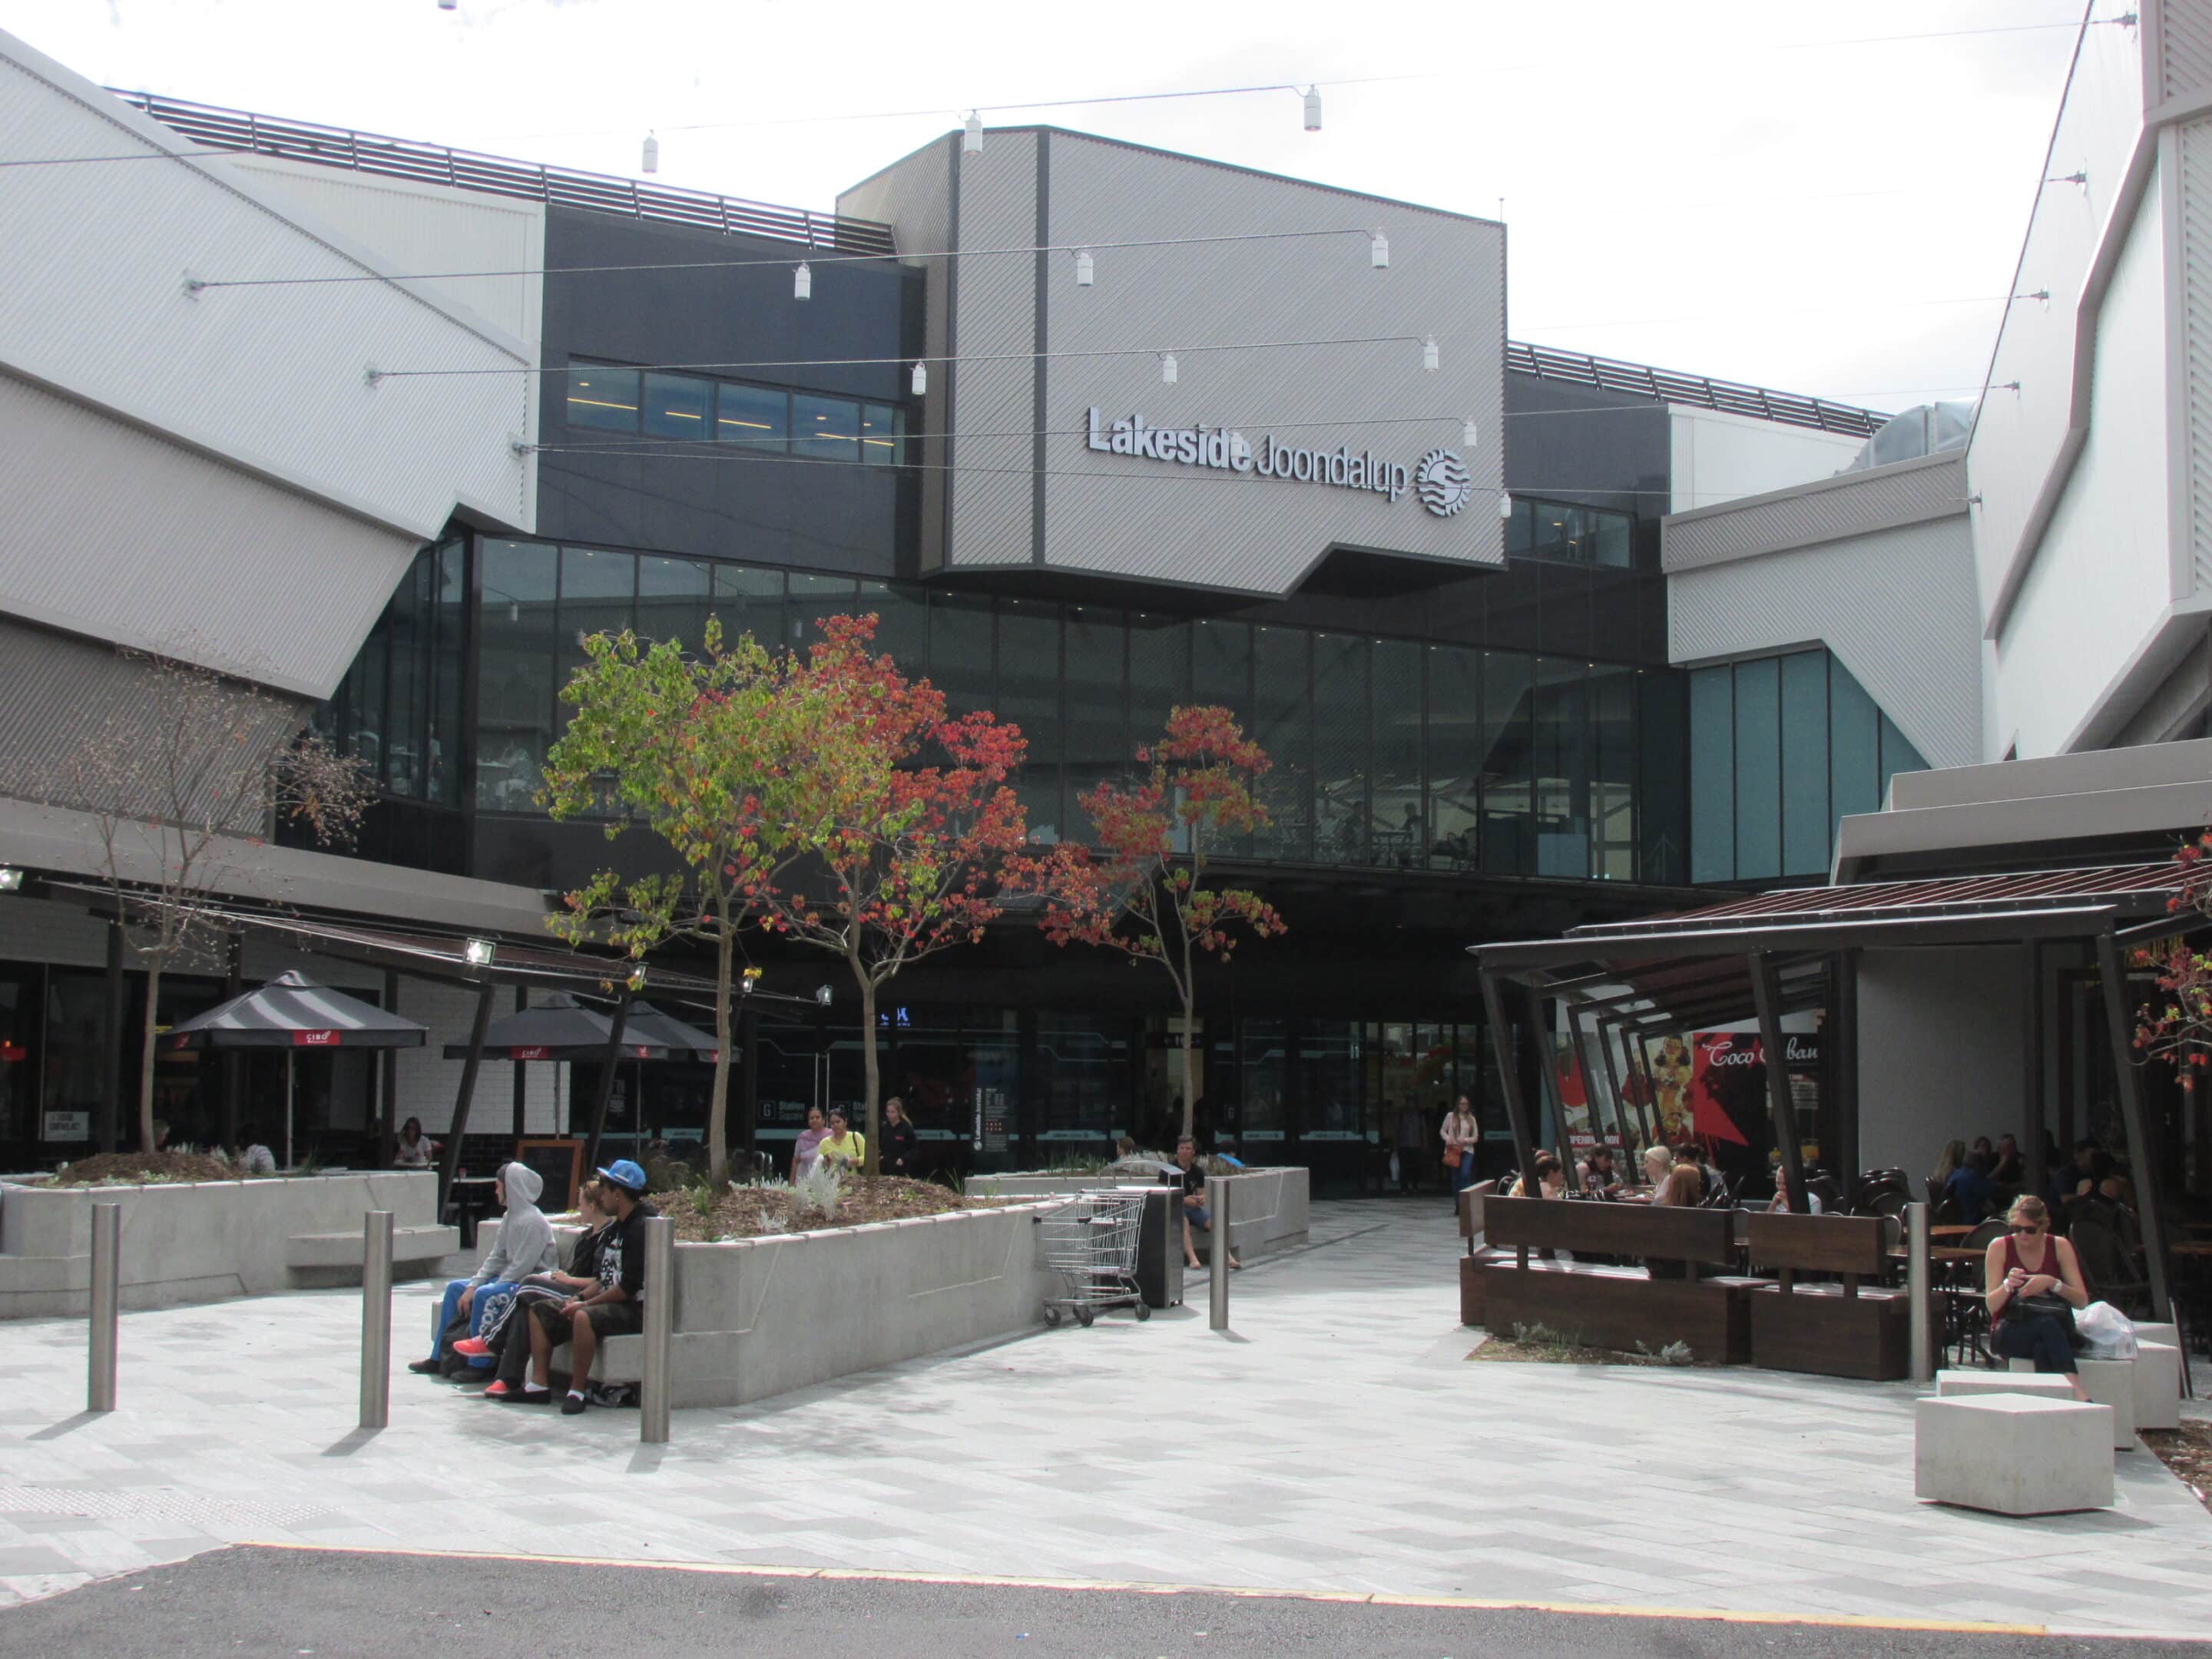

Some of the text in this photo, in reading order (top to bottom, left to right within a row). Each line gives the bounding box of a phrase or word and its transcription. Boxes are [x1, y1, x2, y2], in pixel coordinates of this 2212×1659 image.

[1088, 406, 1408, 502] Lakeside Joondalup
[1702, 1037, 1819, 1066] Coco ban
[1569, 1135, 1596, 1144] PENIN
